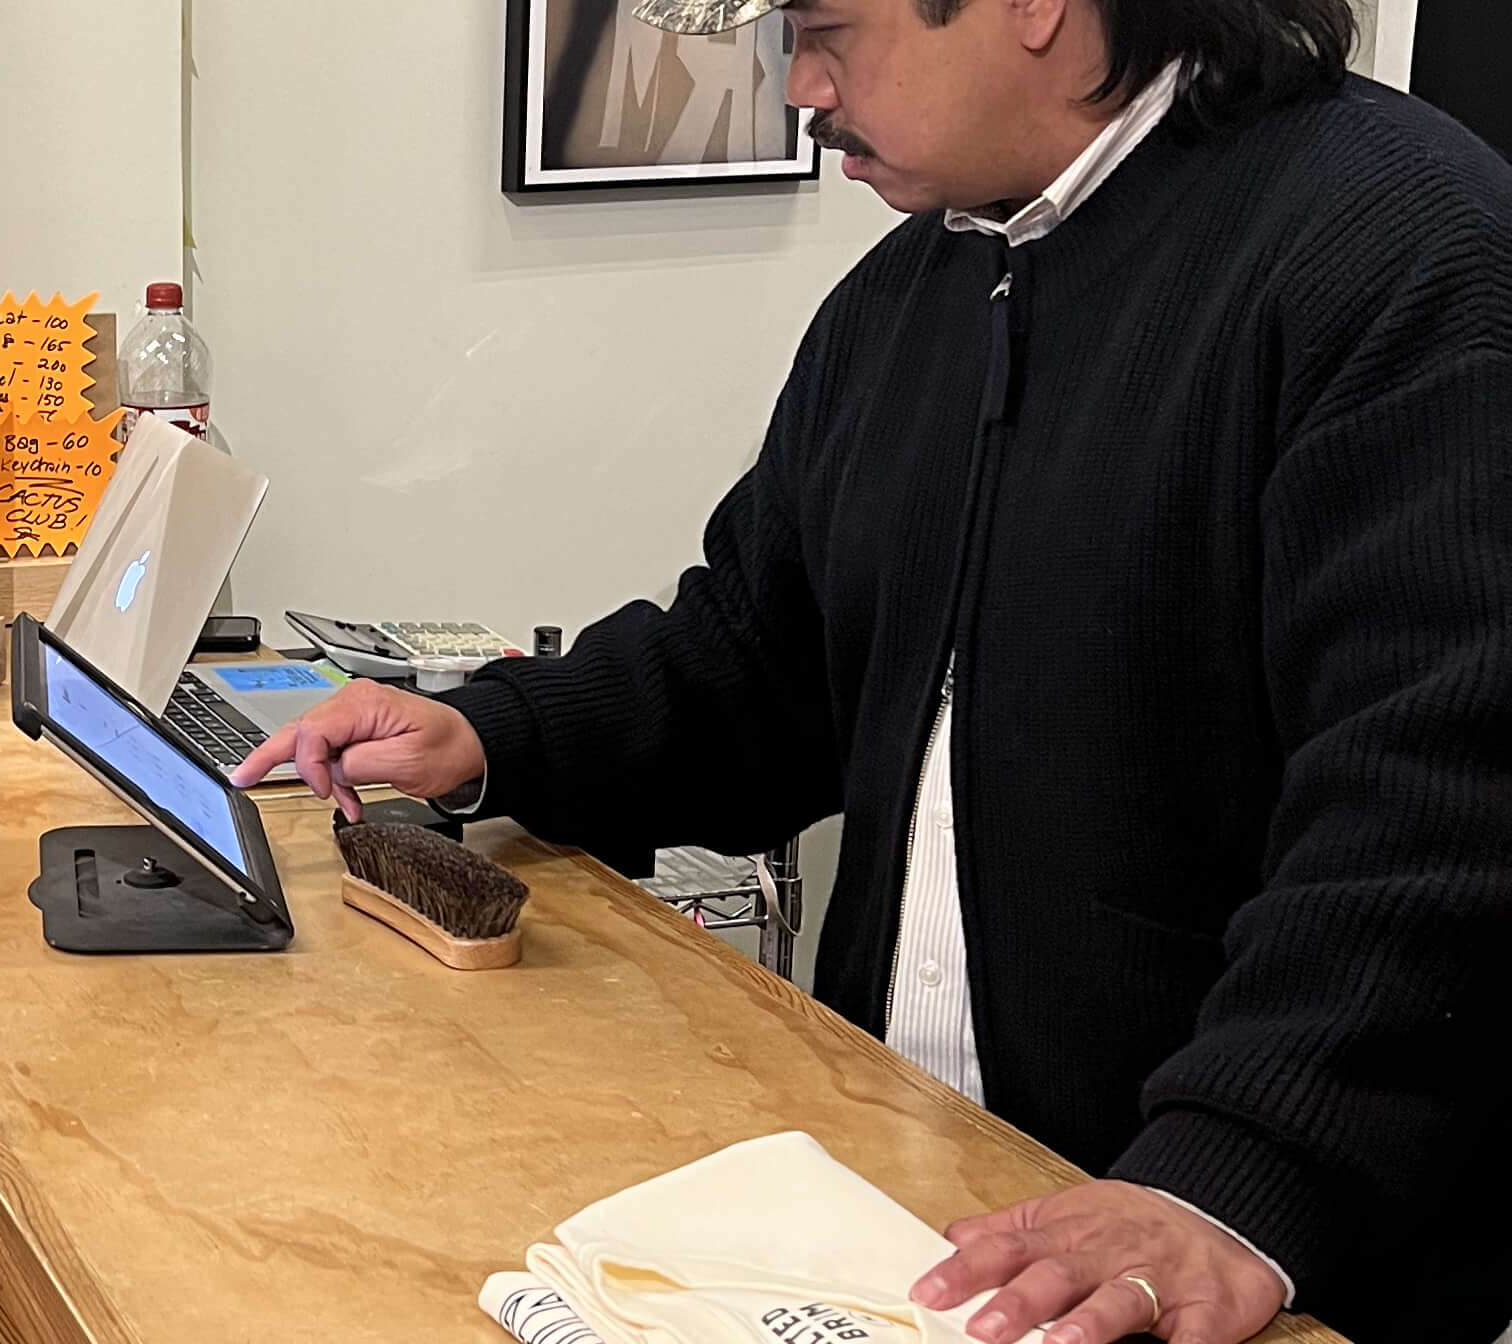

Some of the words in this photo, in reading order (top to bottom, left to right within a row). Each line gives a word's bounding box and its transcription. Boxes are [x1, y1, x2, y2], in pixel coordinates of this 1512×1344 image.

[40, 336, 72, 351] 165
[37, 358, 66, 373] 200
[40, 376, 63, 391] 130
[37, 393, 65, 406] 150
[4, 434, 39, 455] Bag
[0, 456, 71, 474] Keychain
[800, 1302, 869, 1341] BRIM
